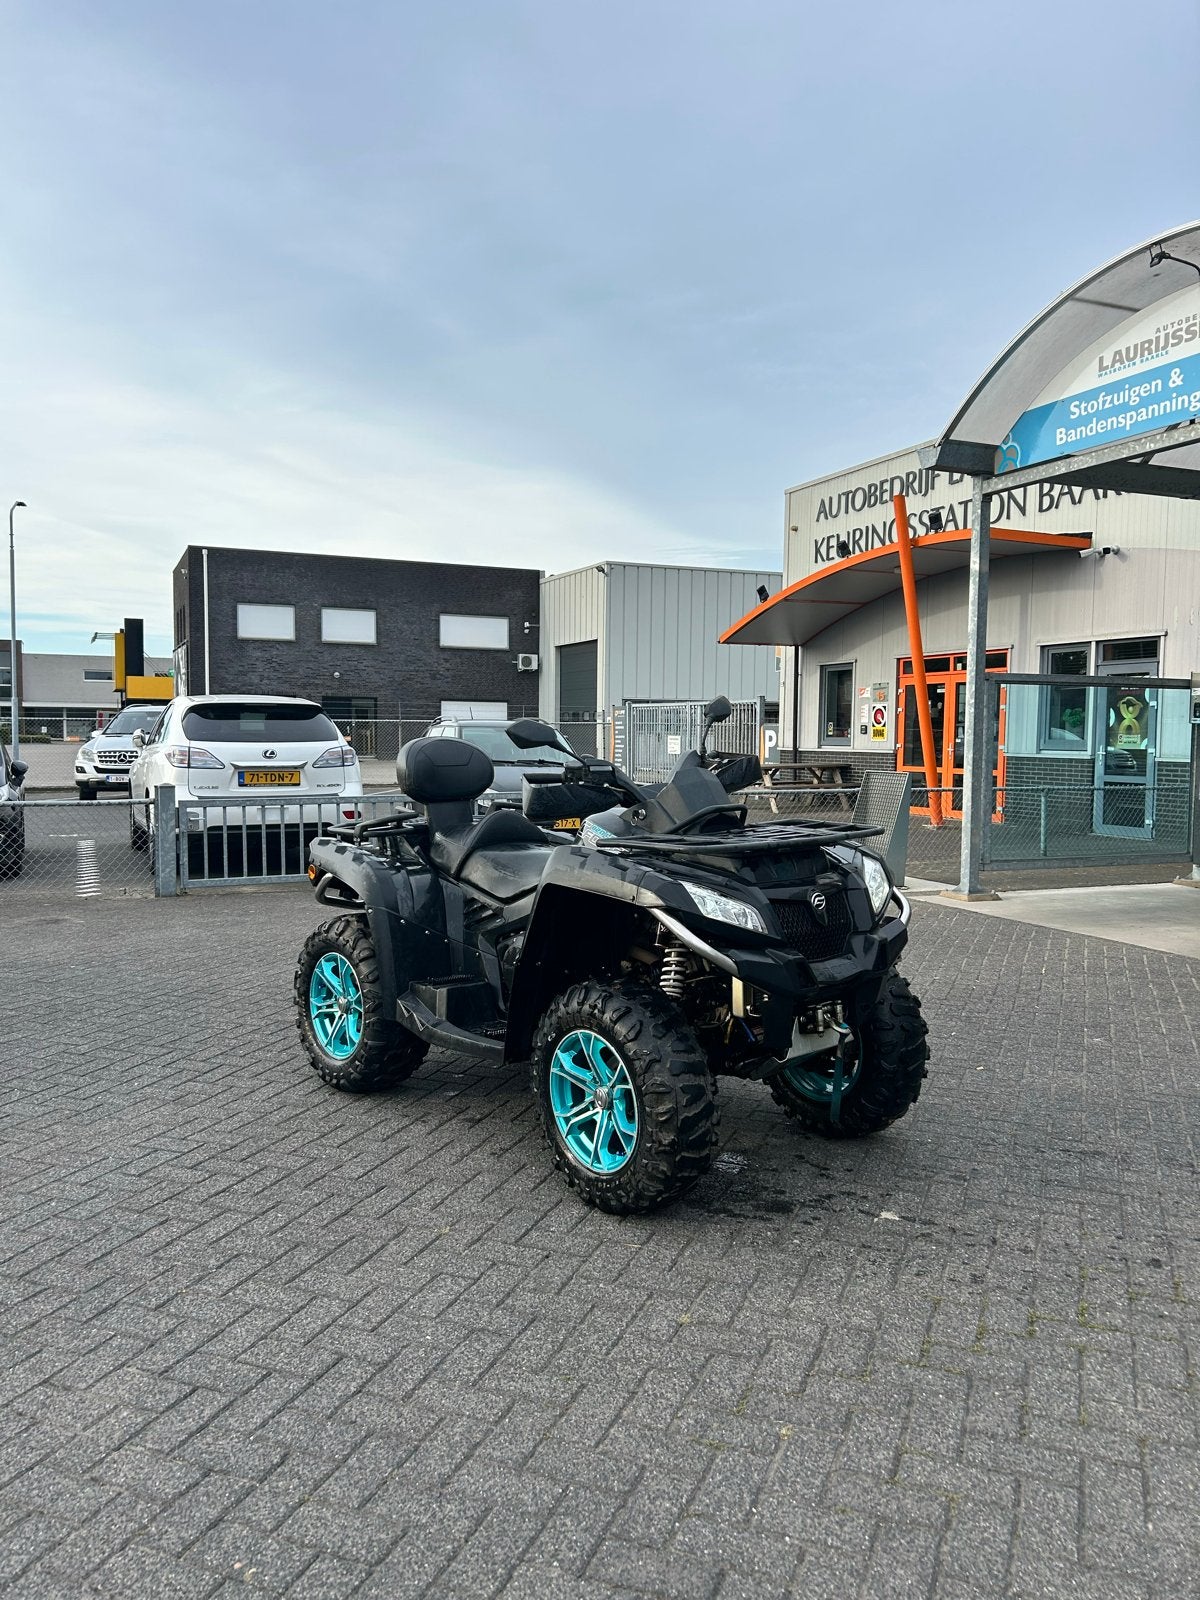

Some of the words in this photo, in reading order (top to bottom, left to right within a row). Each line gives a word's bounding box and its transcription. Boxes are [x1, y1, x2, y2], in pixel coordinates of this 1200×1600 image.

[1098, 321, 1200, 373] LAURIJSS
[1155, 313, 1200, 335] AUTOBE
[1056, 391, 1200, 446] Bandenspanning
[1069, 378, 1163, 420] Stofzuigen
[1168, 367, 1184, 389] &
[815, 469, 941, 522] AUTOBEDRIJF
[764, 730, 777, 759] P
[249, 773, 294, 783] 71-TDN-7
